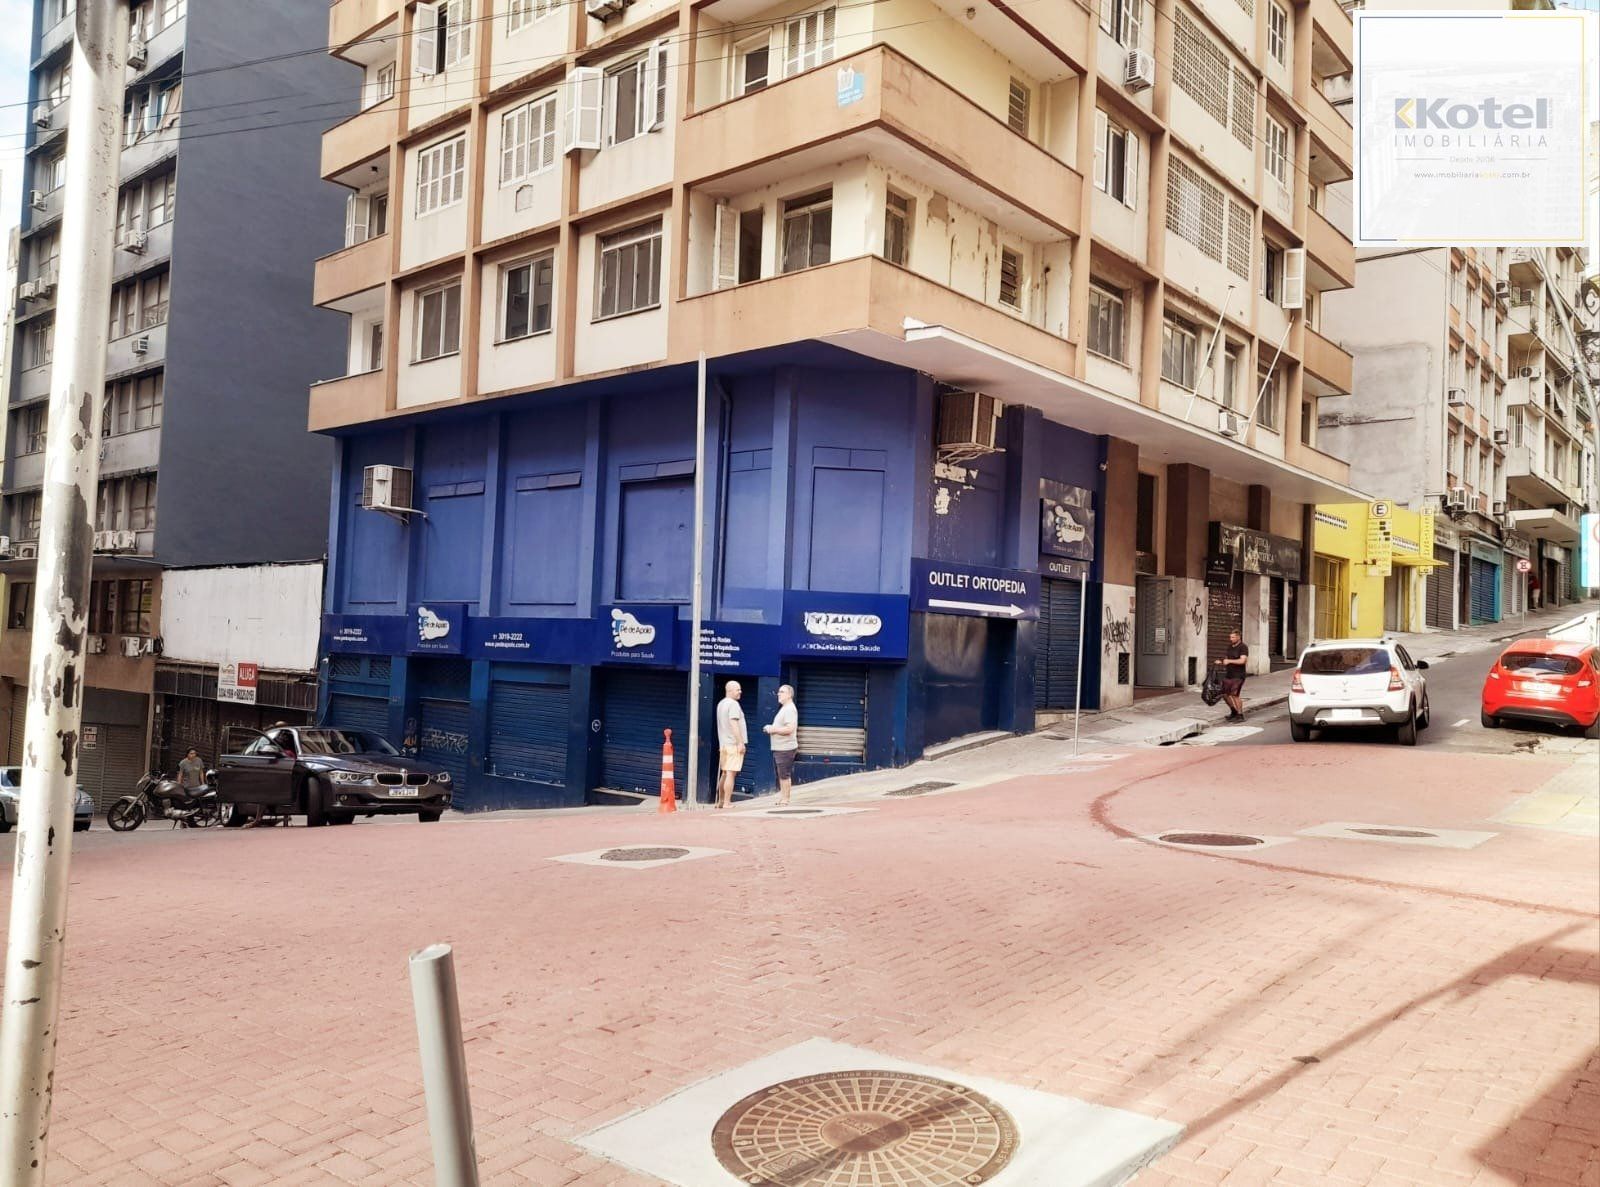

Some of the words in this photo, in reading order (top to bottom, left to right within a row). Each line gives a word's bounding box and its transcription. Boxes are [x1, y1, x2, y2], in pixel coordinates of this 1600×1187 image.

[1376, 504, 1385, 515] E
[1049, 562, 1072, 574] OUTLET
[929, 571, 970, 589] OUTLET
[972, 575, 1026, 595] ORTOPEDIA
[239, 666, 256, 681] ALUGA
